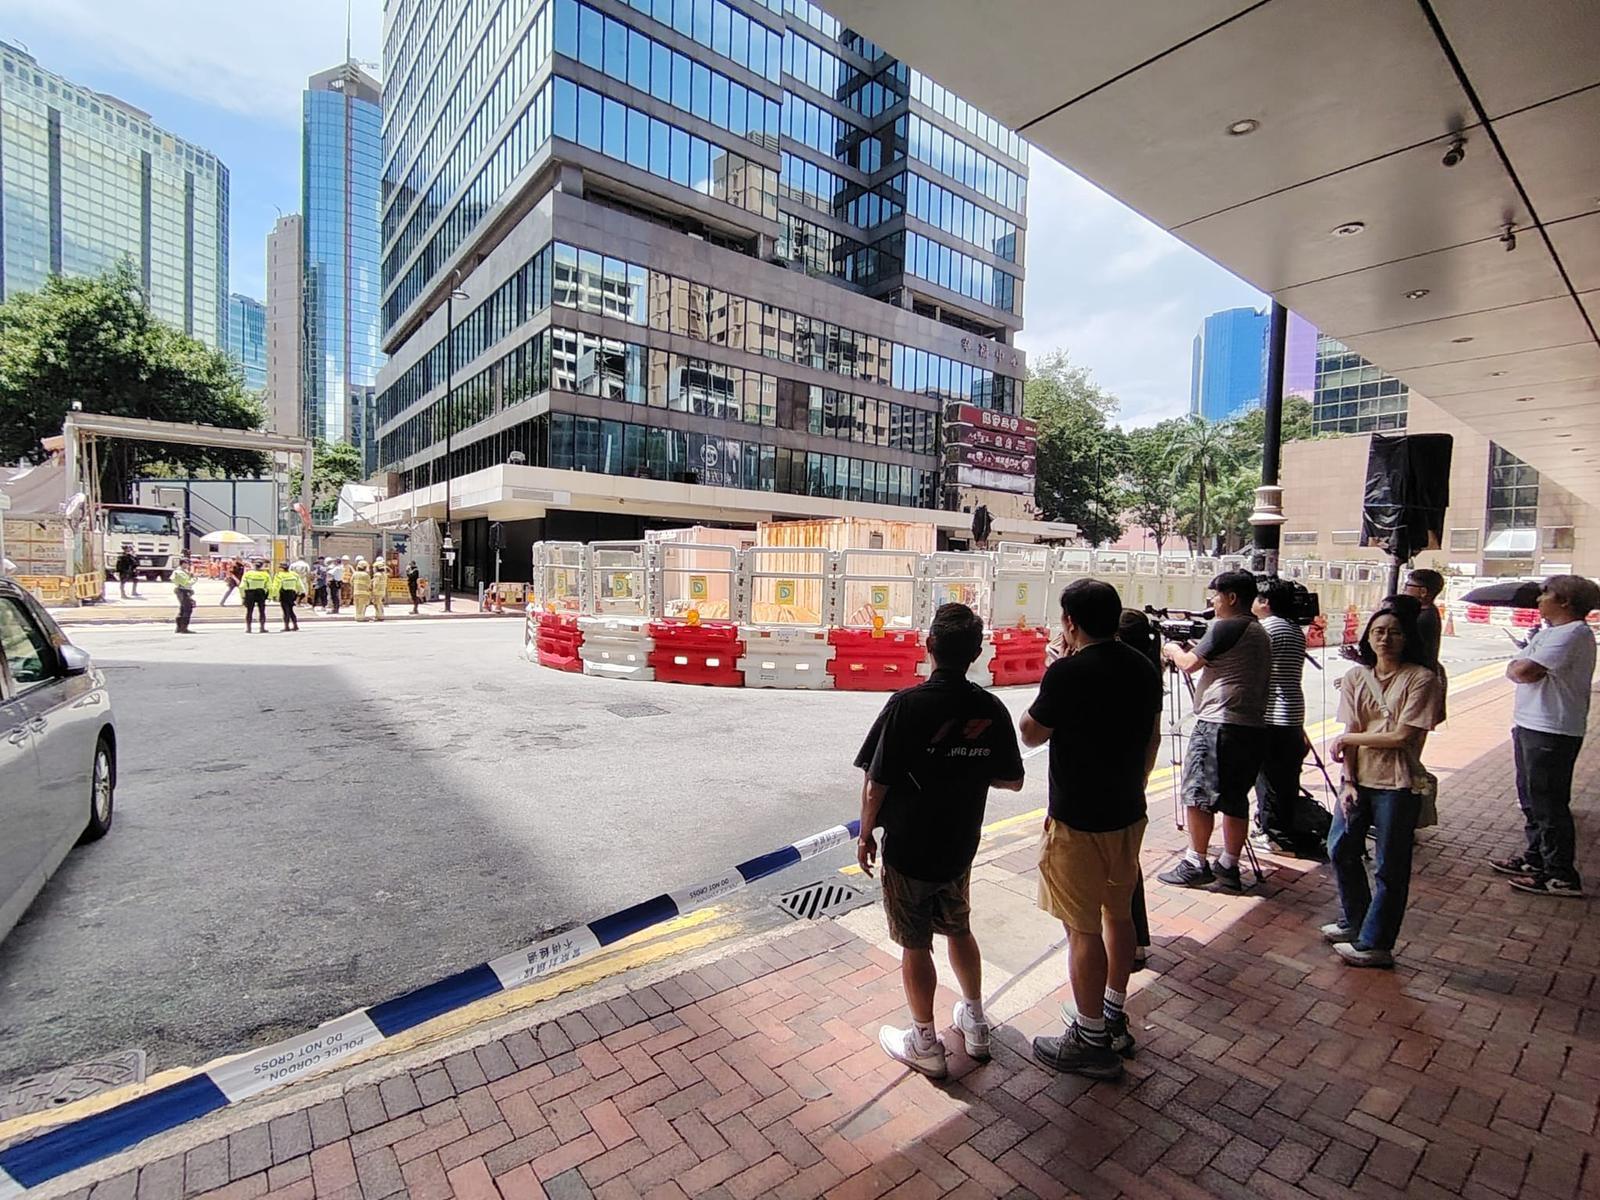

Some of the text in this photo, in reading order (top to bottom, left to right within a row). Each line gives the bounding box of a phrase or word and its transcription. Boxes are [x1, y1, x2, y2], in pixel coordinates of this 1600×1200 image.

[708, 882, 721, 891] NOT
[720, 877, 730, 887] DO
[688, 887, 708, 899] CROSS
[253, 1032, 343, 1075] DO NOT CROSS
[269, 1036, 364, 1082] POLICE CORDON
